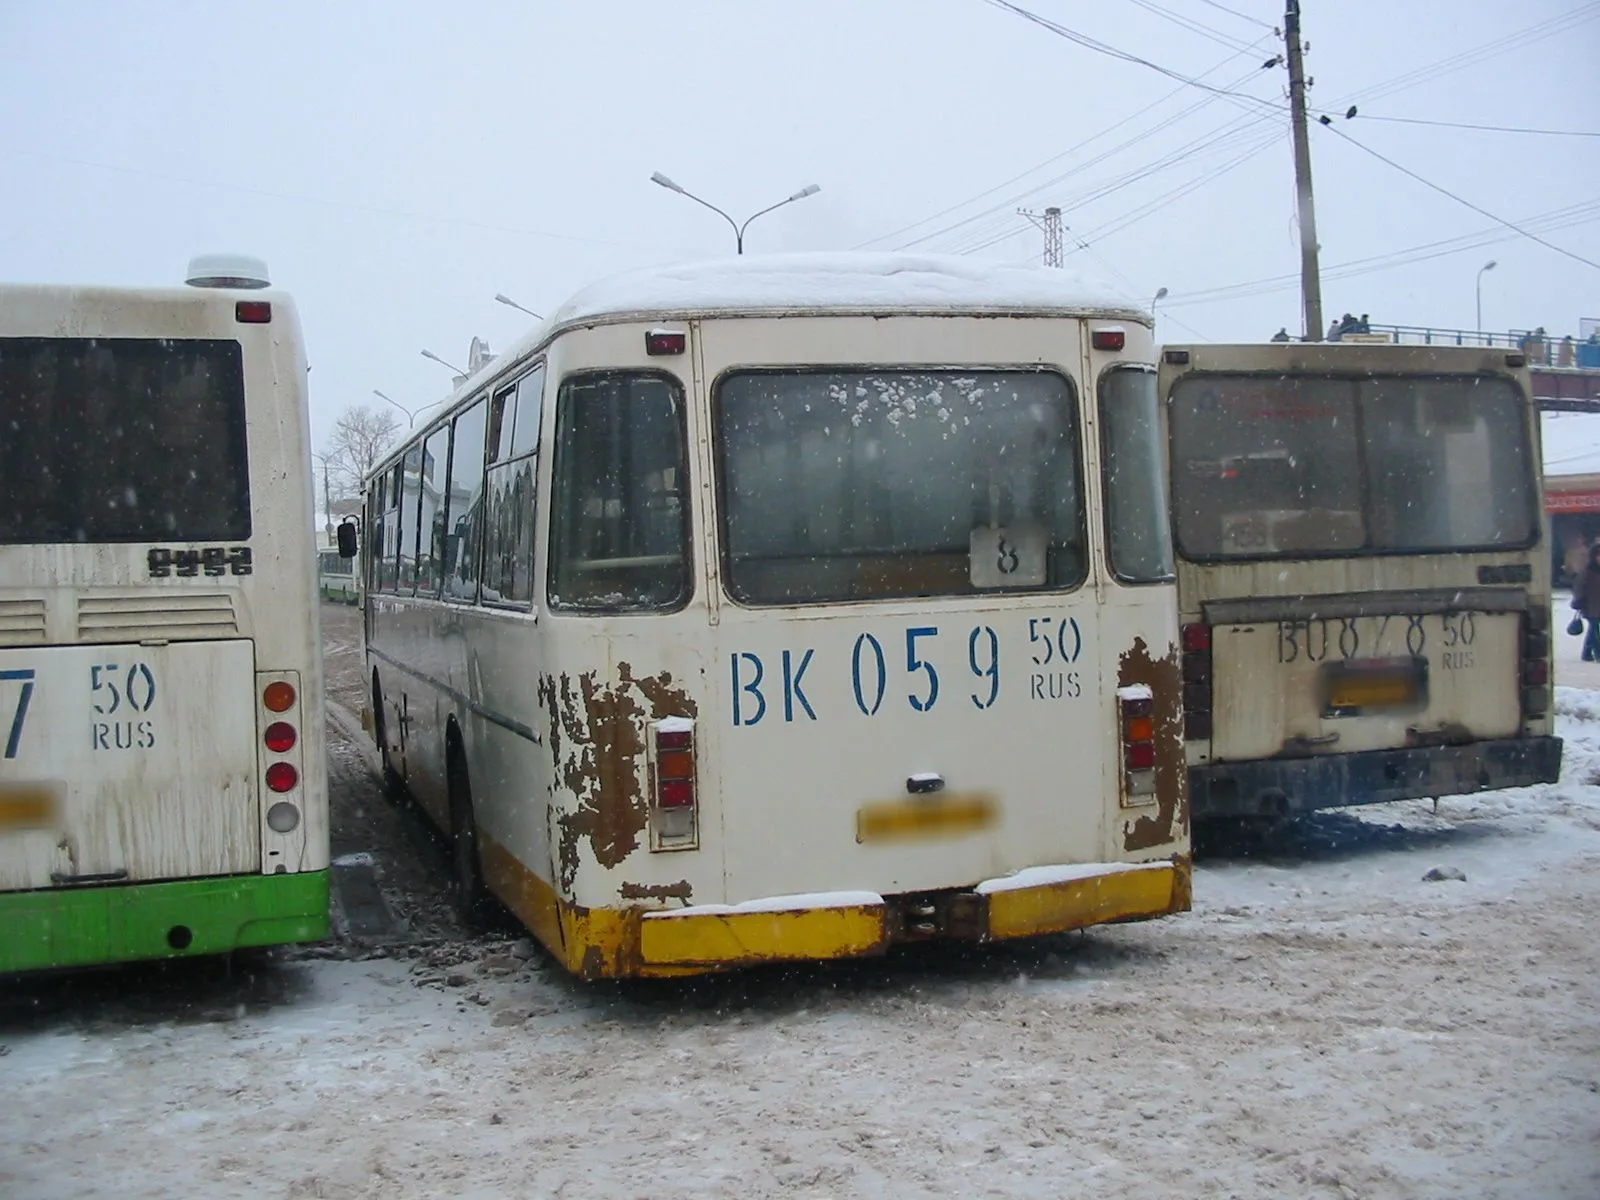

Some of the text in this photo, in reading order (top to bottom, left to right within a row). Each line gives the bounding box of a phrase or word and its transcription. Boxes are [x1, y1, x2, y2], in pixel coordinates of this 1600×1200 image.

[1029, 616, 1081, 665] 50
[1443, 610, 1474, 647] 50
[852, 625, 999, 716] 059
[1442, 653, 1474, 669] RUS
[91, 663, 156, 714] 50
[1031, 672, 1081, 700] RUS
[0, 669, 36, 759] 7
[93, 721, 155, 750] RUS
